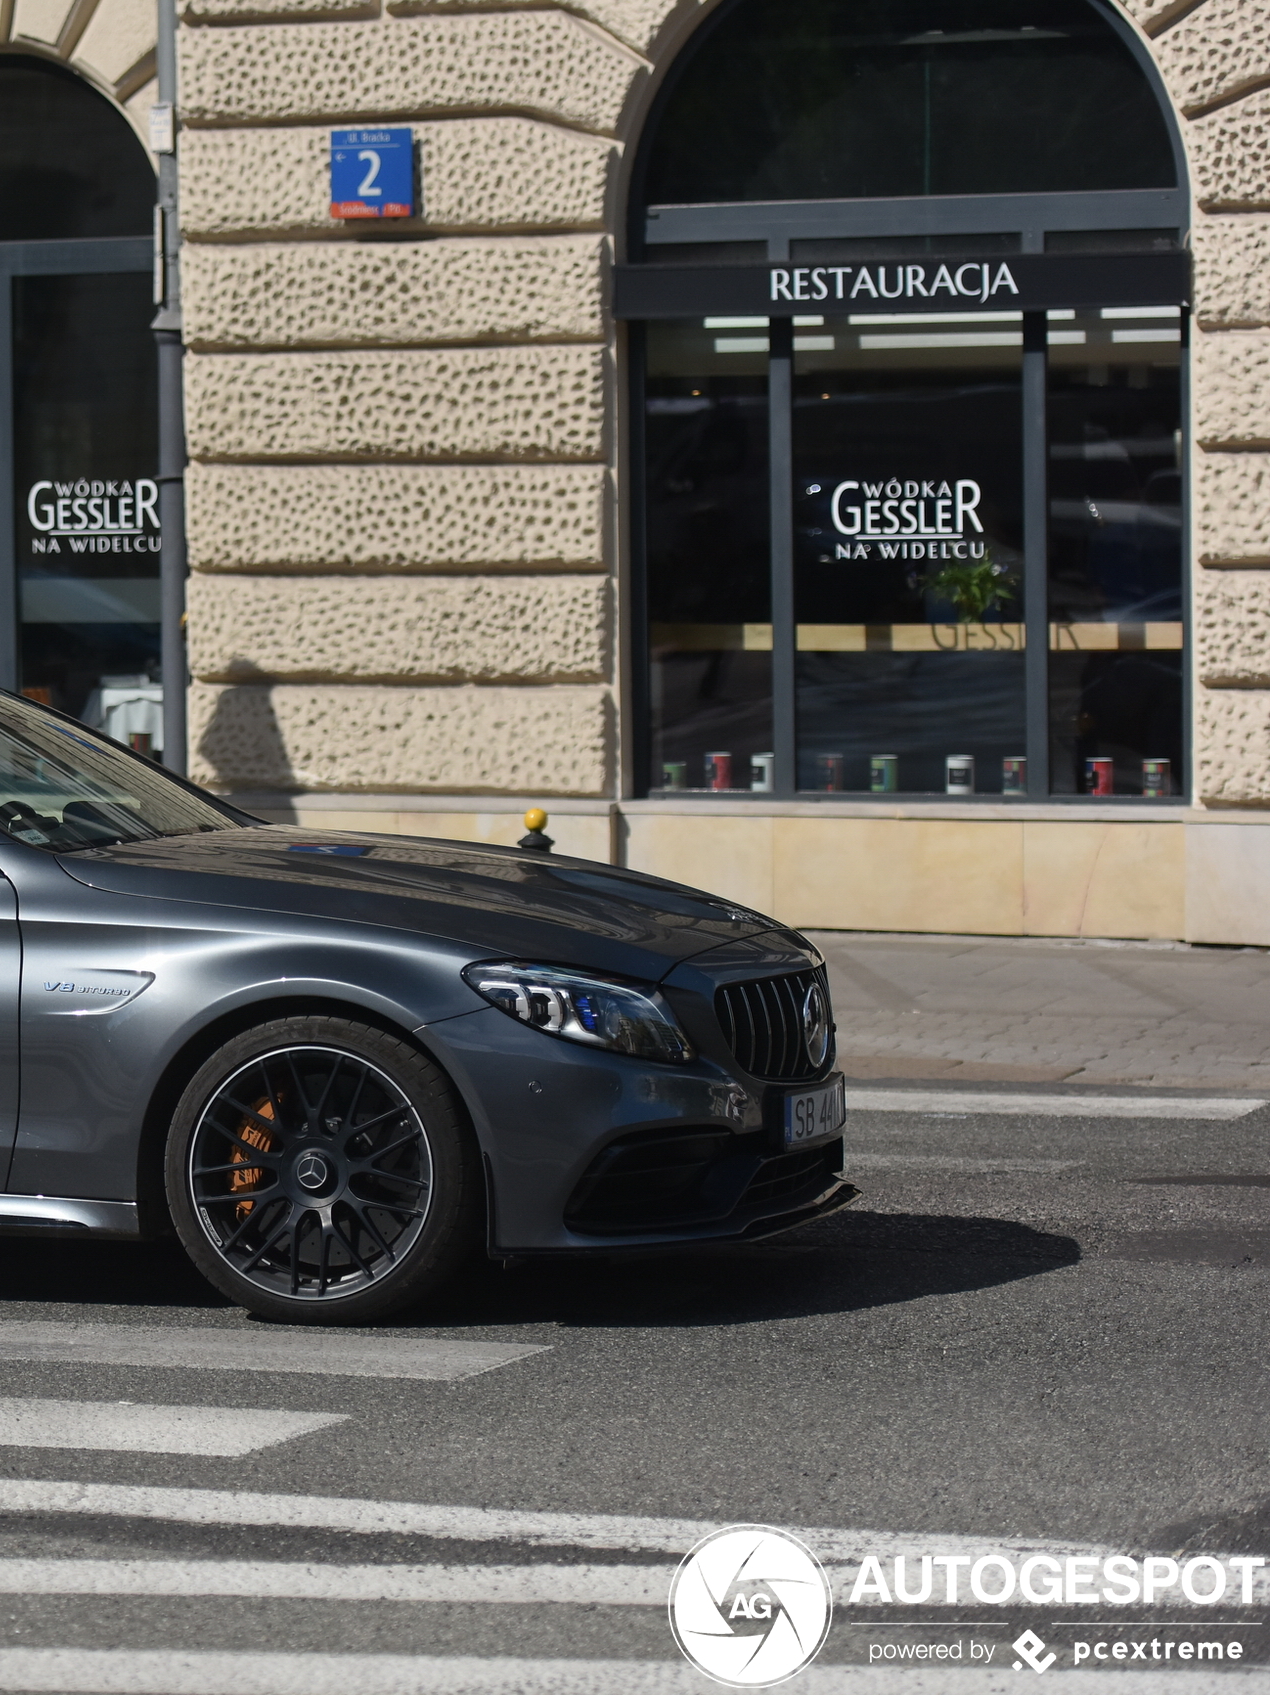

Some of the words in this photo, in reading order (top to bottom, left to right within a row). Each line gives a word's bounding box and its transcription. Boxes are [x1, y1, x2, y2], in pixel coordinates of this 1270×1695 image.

[357, 150, 383, 197] 2
[770, 262, 1020, 303] RESTAURACJA
[53, 476, 133, 498] WÓDKA
[861, 476, 953, 499] WÓDKA
[27, 478, 161, 531] GESSLER
[831, 479, 984, 535] GESSLER
[32, 537, 62, 554] NA
[68, 535, 162, 554] WIDELCU
[835, 542, 868, 560] NA
[879, 540, 984, 560] WIDELCU
[43, 981, 76, 993] V8
[76, 985, 131, 996] BITURBO
[795, 1097, 815, 1138] SB
